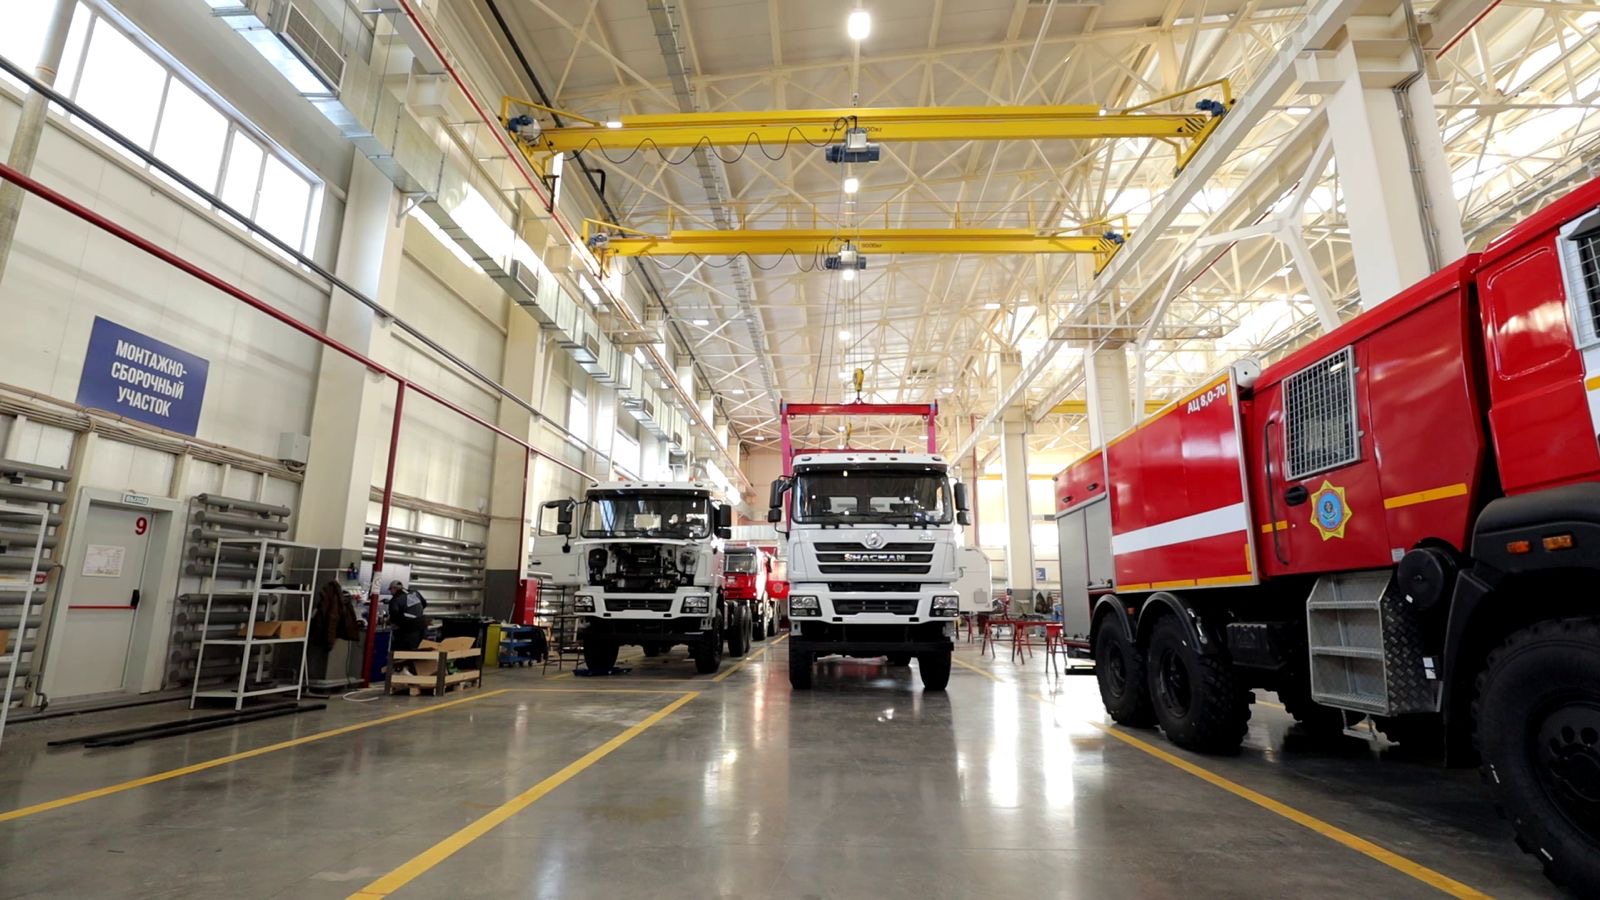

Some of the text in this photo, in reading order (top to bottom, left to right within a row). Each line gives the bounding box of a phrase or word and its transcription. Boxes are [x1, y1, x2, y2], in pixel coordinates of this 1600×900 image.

[115, 339, 188, 378] МОНТАЖНО-
[111, 361, 184, 400] СБОРОЧНЫЙ
[116, 386, 172, 417] УЧАСТОК
[1187, 383, 1227, 414] АЦ 8,0-70
[135, 517, 148, 535] 9
[844, 553, 905, 562] SHACMAN
